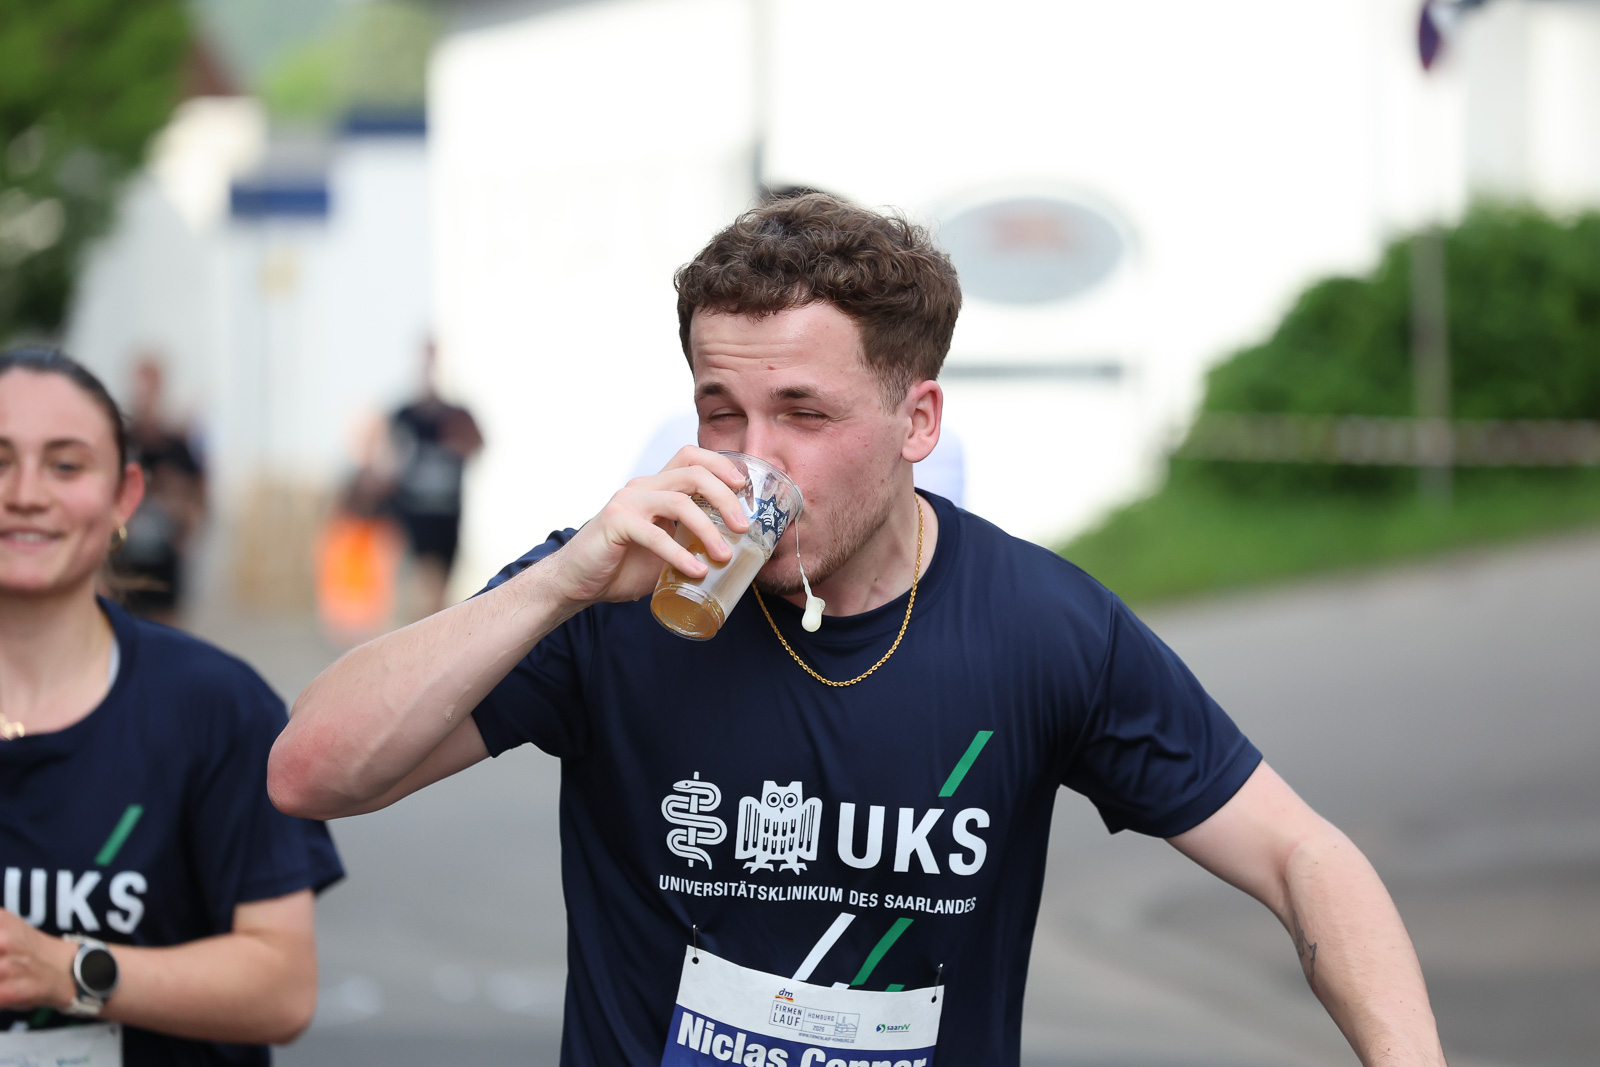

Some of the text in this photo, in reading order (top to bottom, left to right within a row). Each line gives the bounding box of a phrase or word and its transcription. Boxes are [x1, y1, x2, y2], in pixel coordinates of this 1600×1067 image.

[837, 801, 990, 876] UKS
[4, 866, 148, 935] UKS
[659, 874, 977, 915] UNIVERSITÄTSKLINIKUM DES SAARLANDES
[778, 988, 794, 998] dm
[773, 1014, 801, 1027] LAUF
[775, 1004, 803, 1016] FIRMEN
[808, 1012, 835, 1022] HOMBURG
[676, 1011, 789, 1067] Niclas
